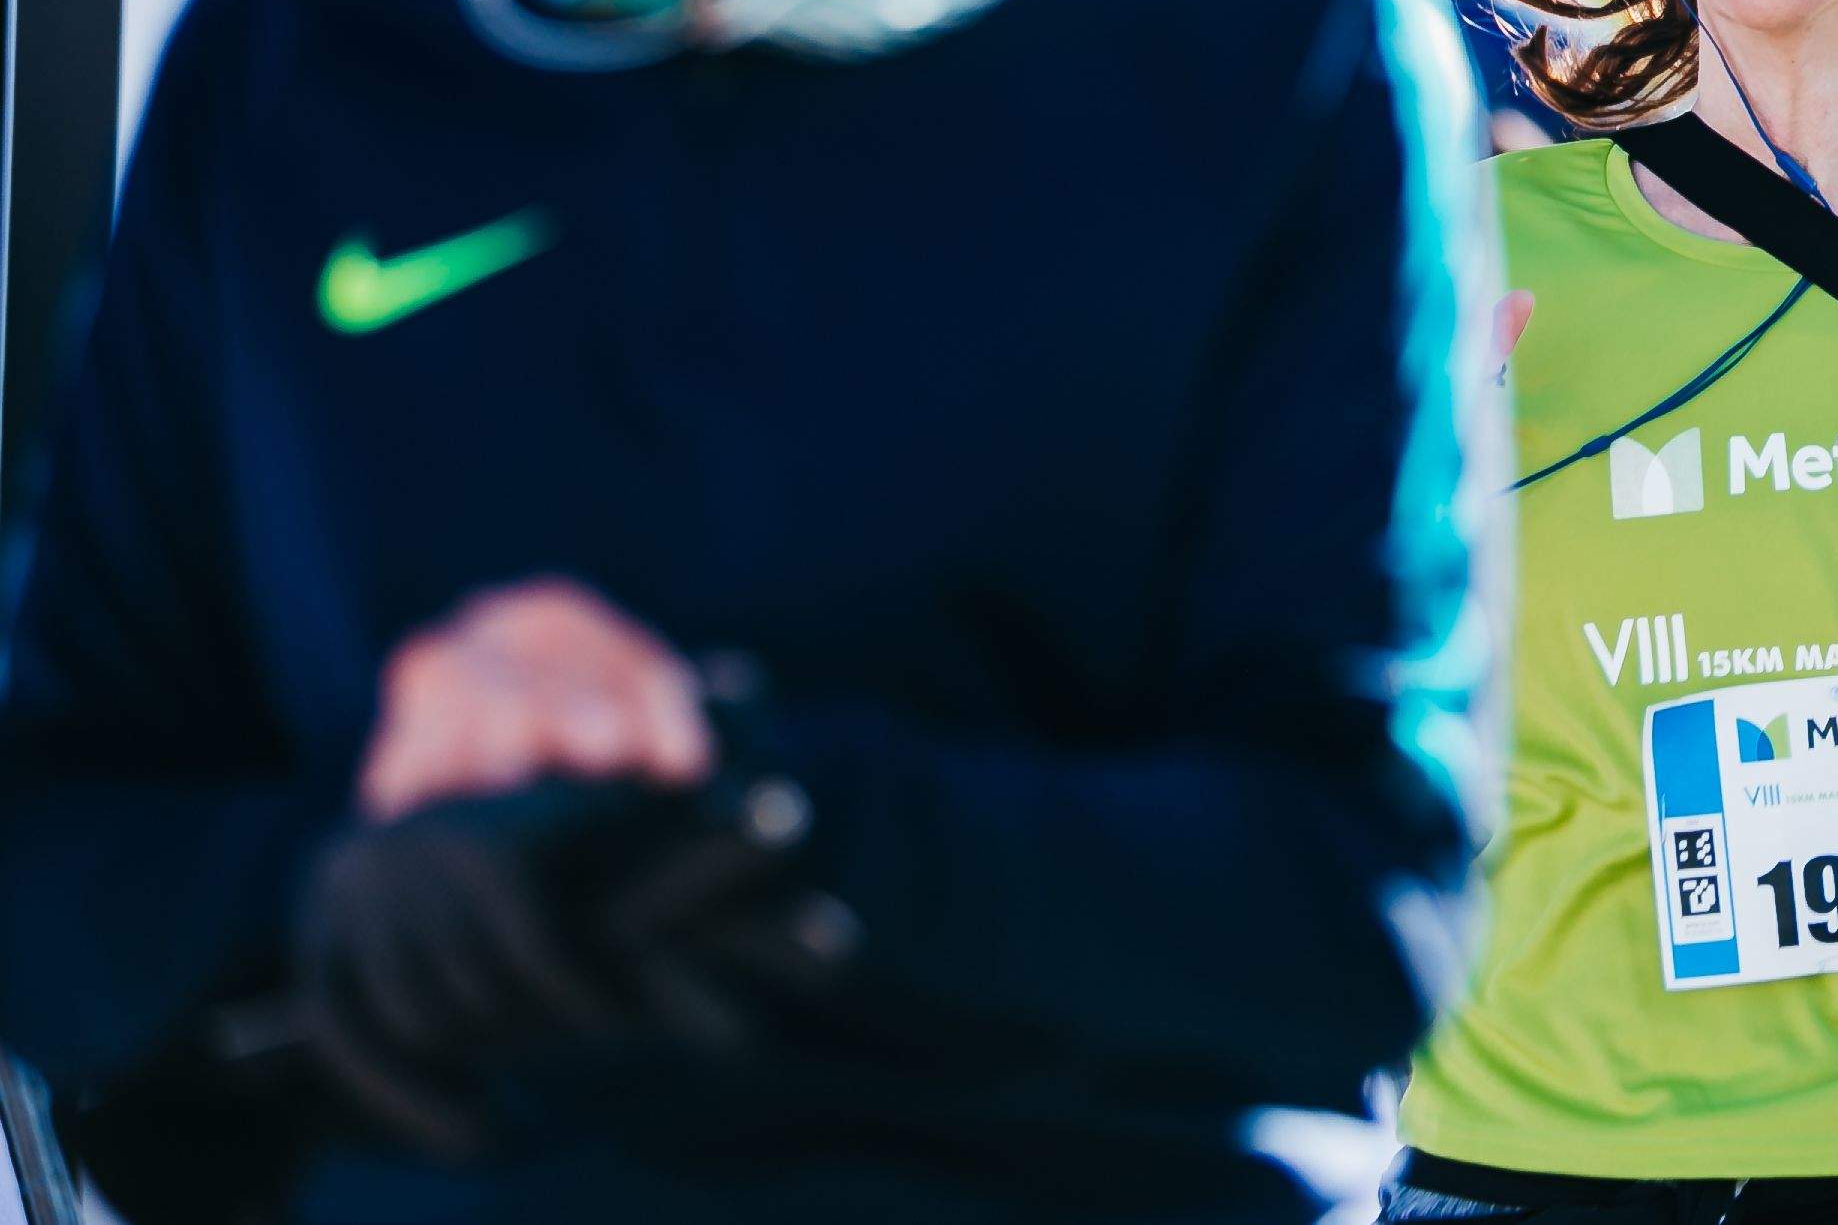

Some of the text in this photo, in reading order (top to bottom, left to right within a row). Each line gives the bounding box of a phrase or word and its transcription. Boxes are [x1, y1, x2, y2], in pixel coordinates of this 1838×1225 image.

[1582, 613, 1689, 687] VIII
[1697, 645, 1784, 678] 15KM
[1743, 782, 1782, 808] VIII
